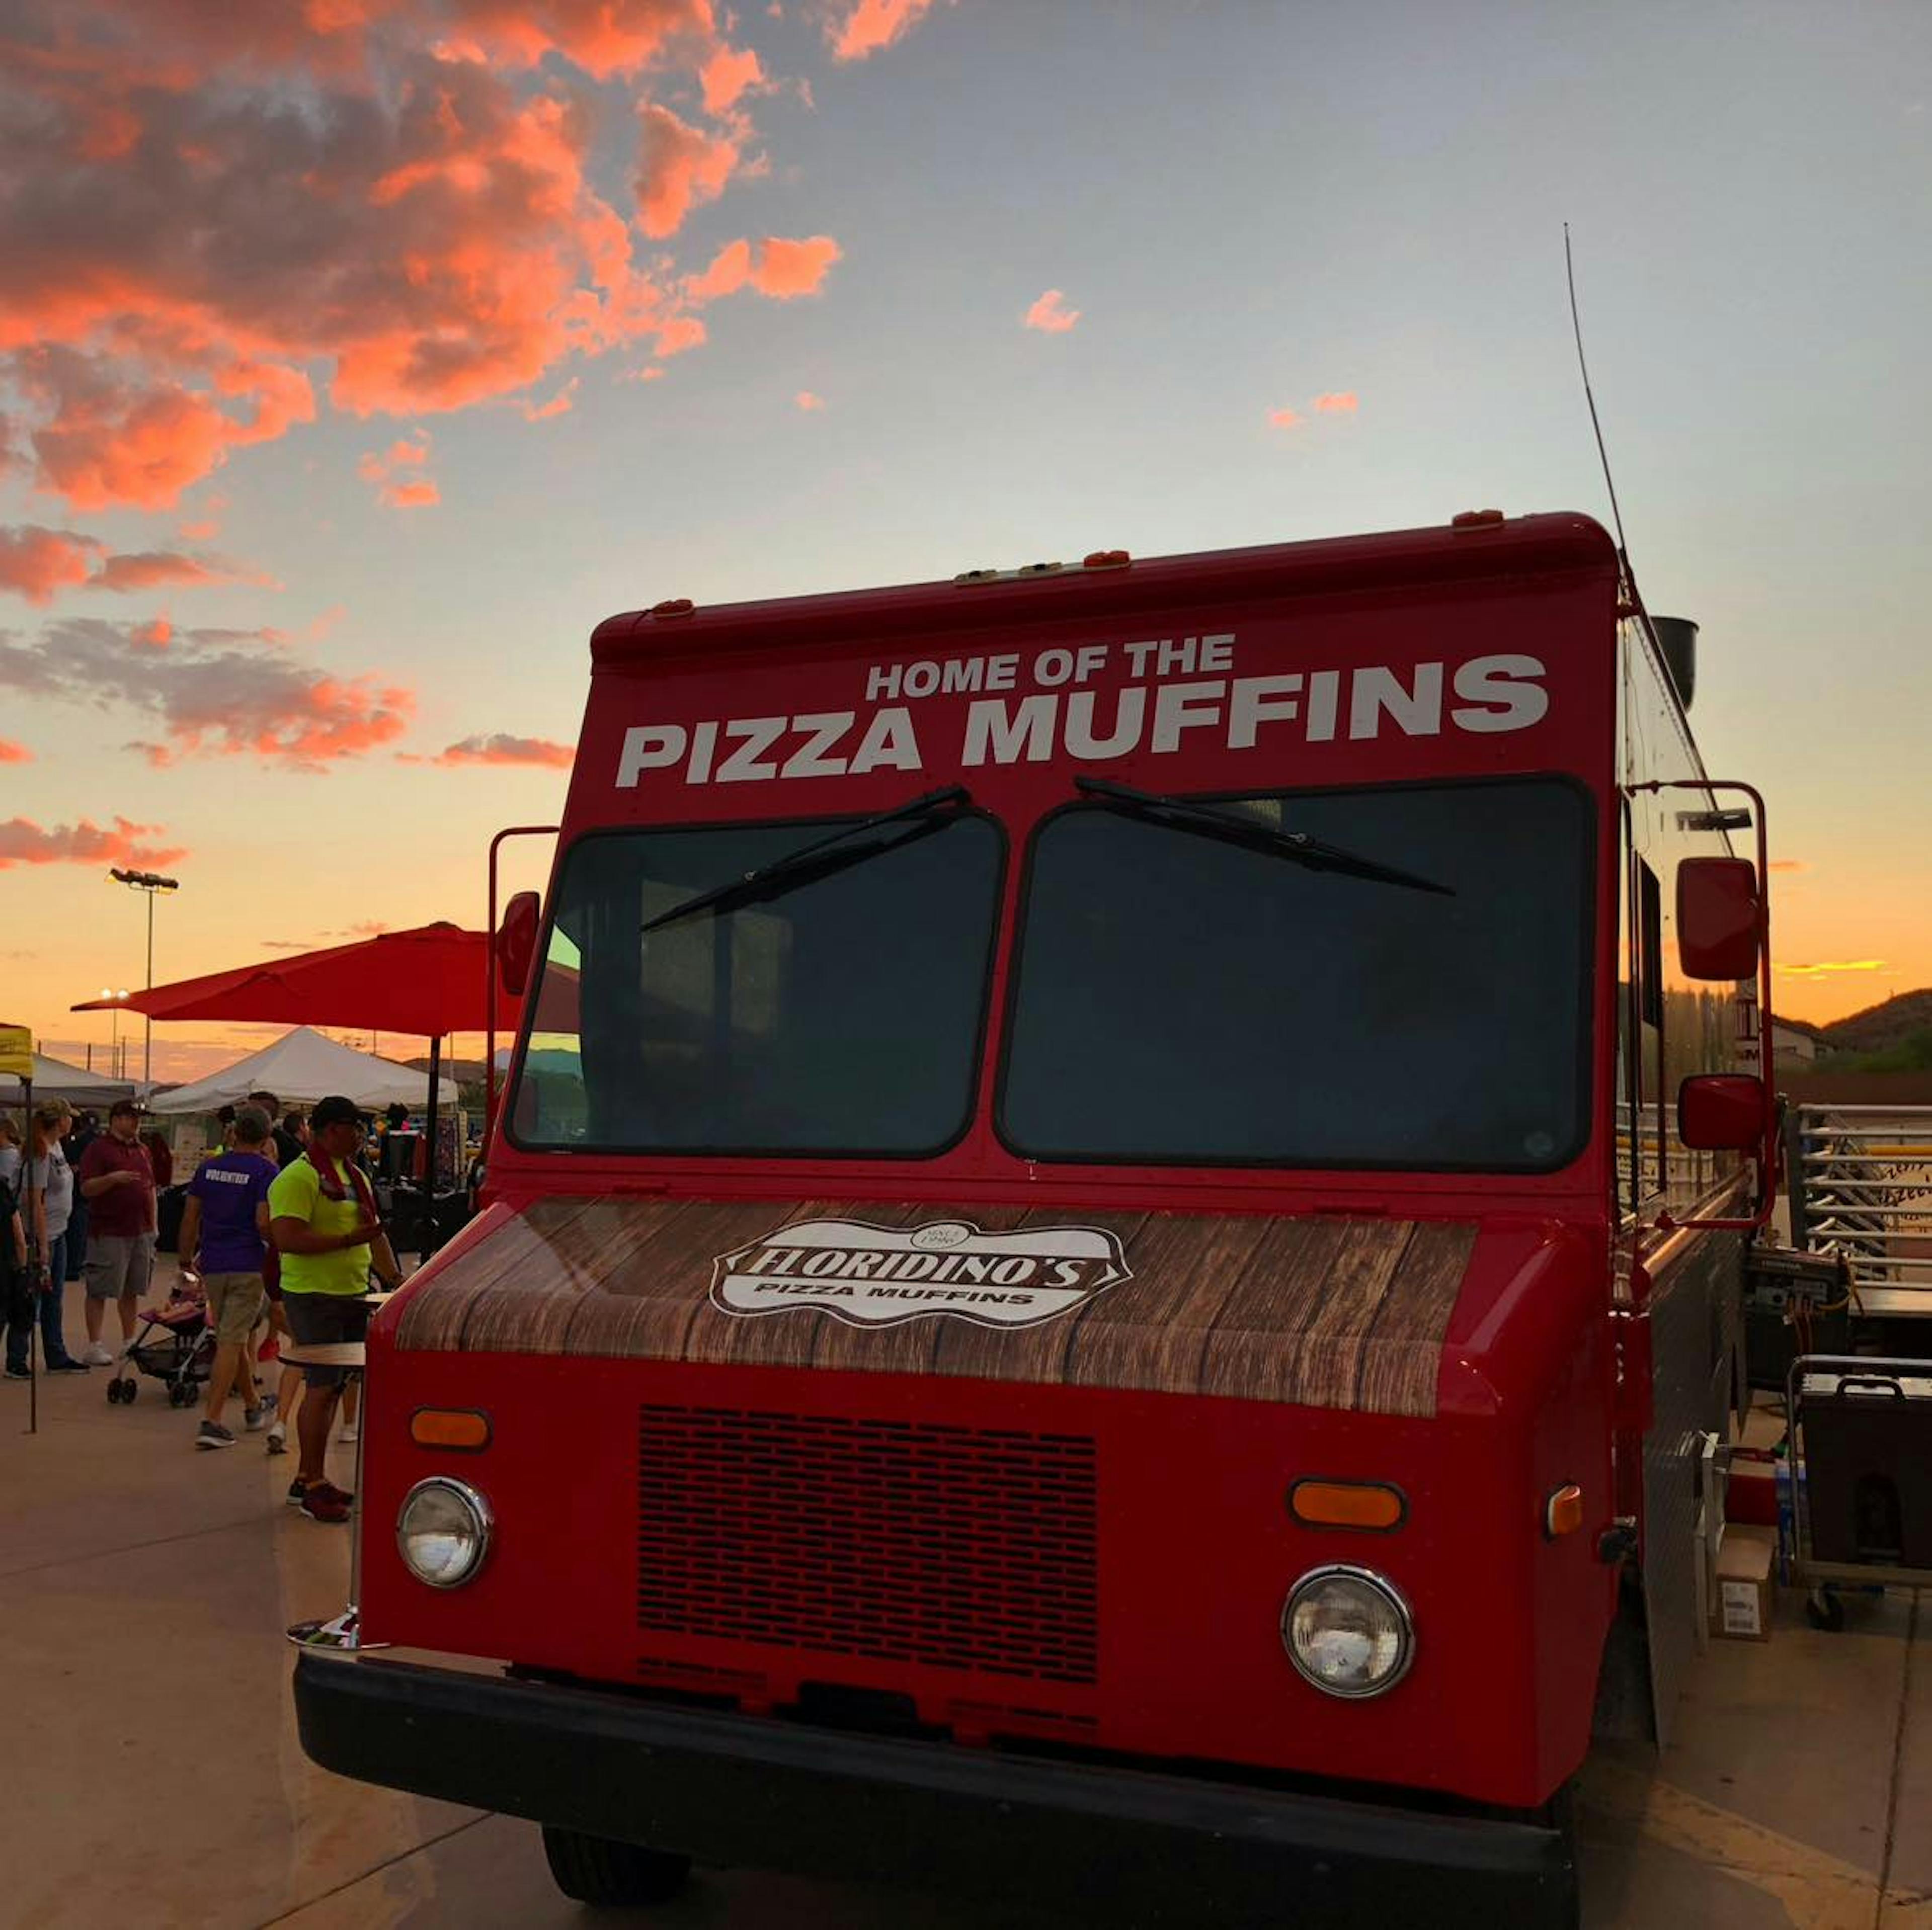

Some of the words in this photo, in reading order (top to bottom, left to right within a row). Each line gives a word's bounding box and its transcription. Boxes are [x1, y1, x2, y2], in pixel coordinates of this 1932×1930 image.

[866, 654, 1019, 701] HOME
[1034, 645, 1107, 686] OF
[1124, 634, 1236, 677] THE
[615, 707, 922, 788] PIZZA
[961, 654, 1549, 766] MUFFINS
[747, 1248, 1086, 1287] FLORIDINO'S
[754, 1283, 853, 1295] PIZZA
[867, 1287, 1034, 1304] MUFFINS
